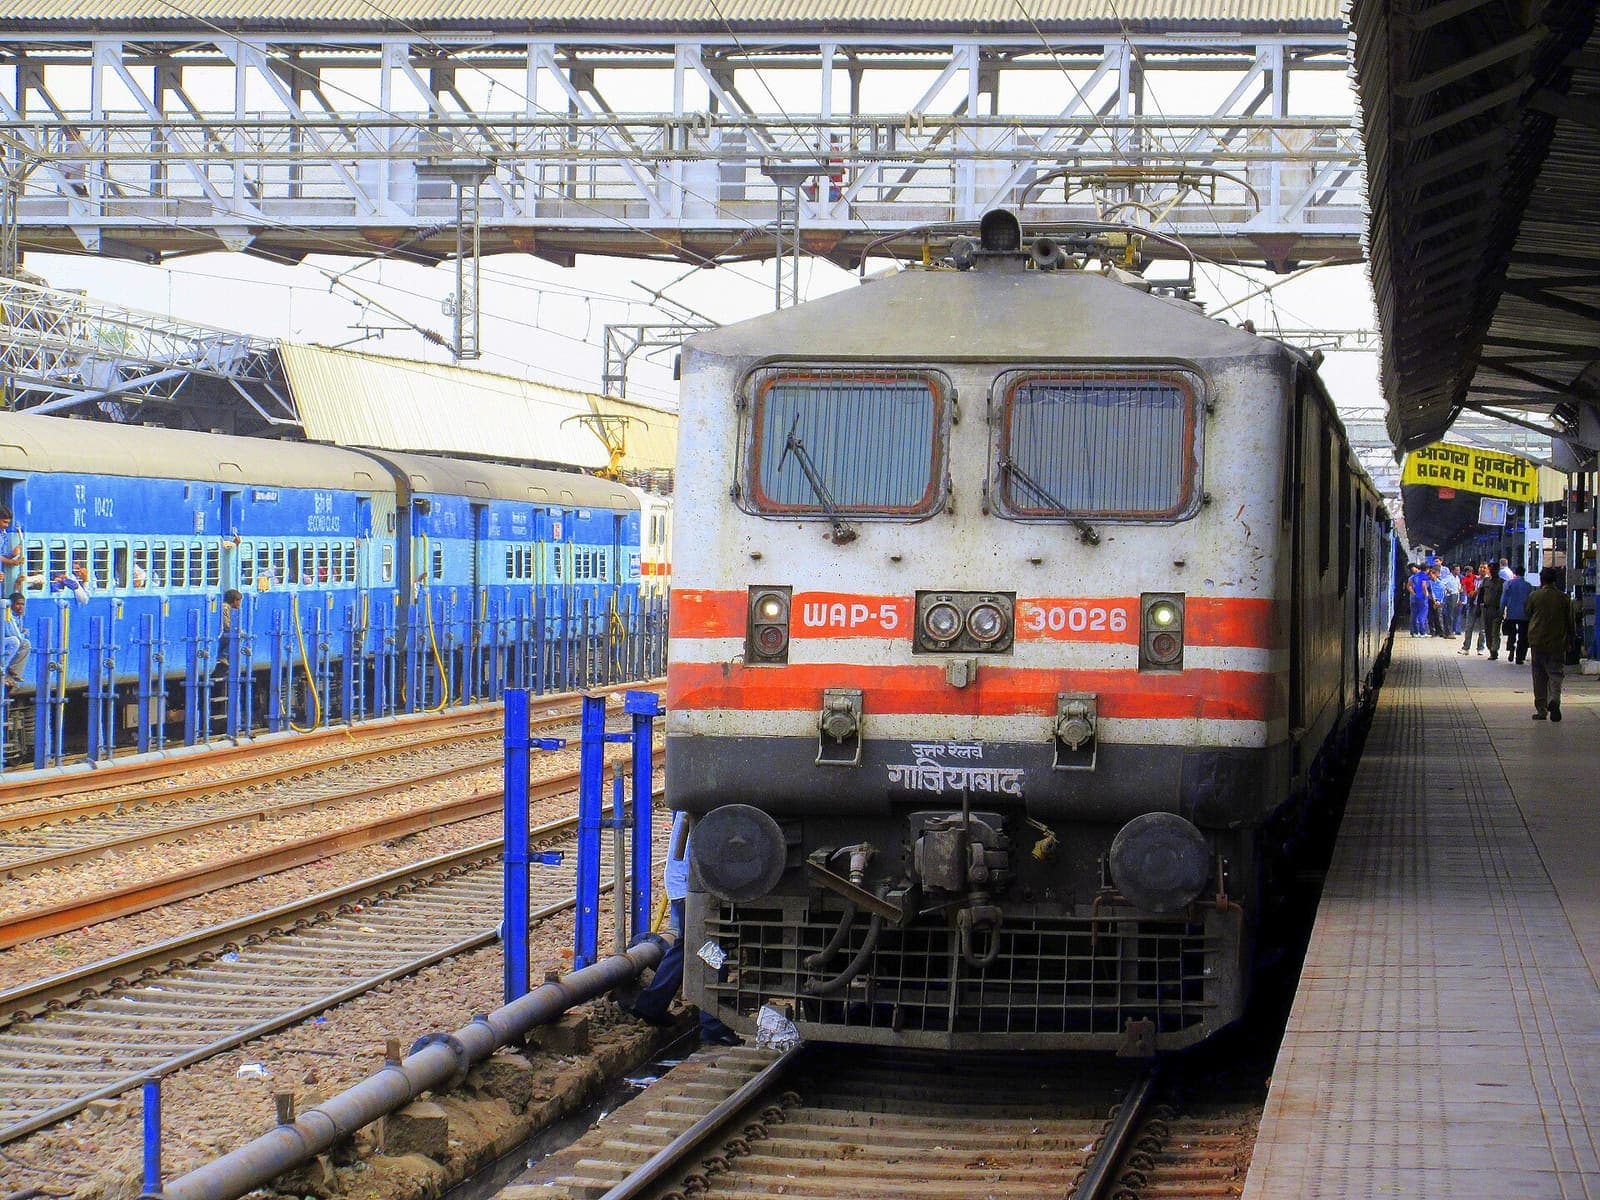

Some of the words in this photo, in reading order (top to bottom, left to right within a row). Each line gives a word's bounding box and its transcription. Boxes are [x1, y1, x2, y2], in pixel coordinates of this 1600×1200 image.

[1417, 463, 1466, 482] AGRA
[1472, 472, 1530, 495] CANTT
[803, 602, 899, 630] WAP-5
[1026, 606, 1128, 632] 30026
[910, 743, 946, 759] उत्तर
[947, 742, 984, 760] रेलवे
